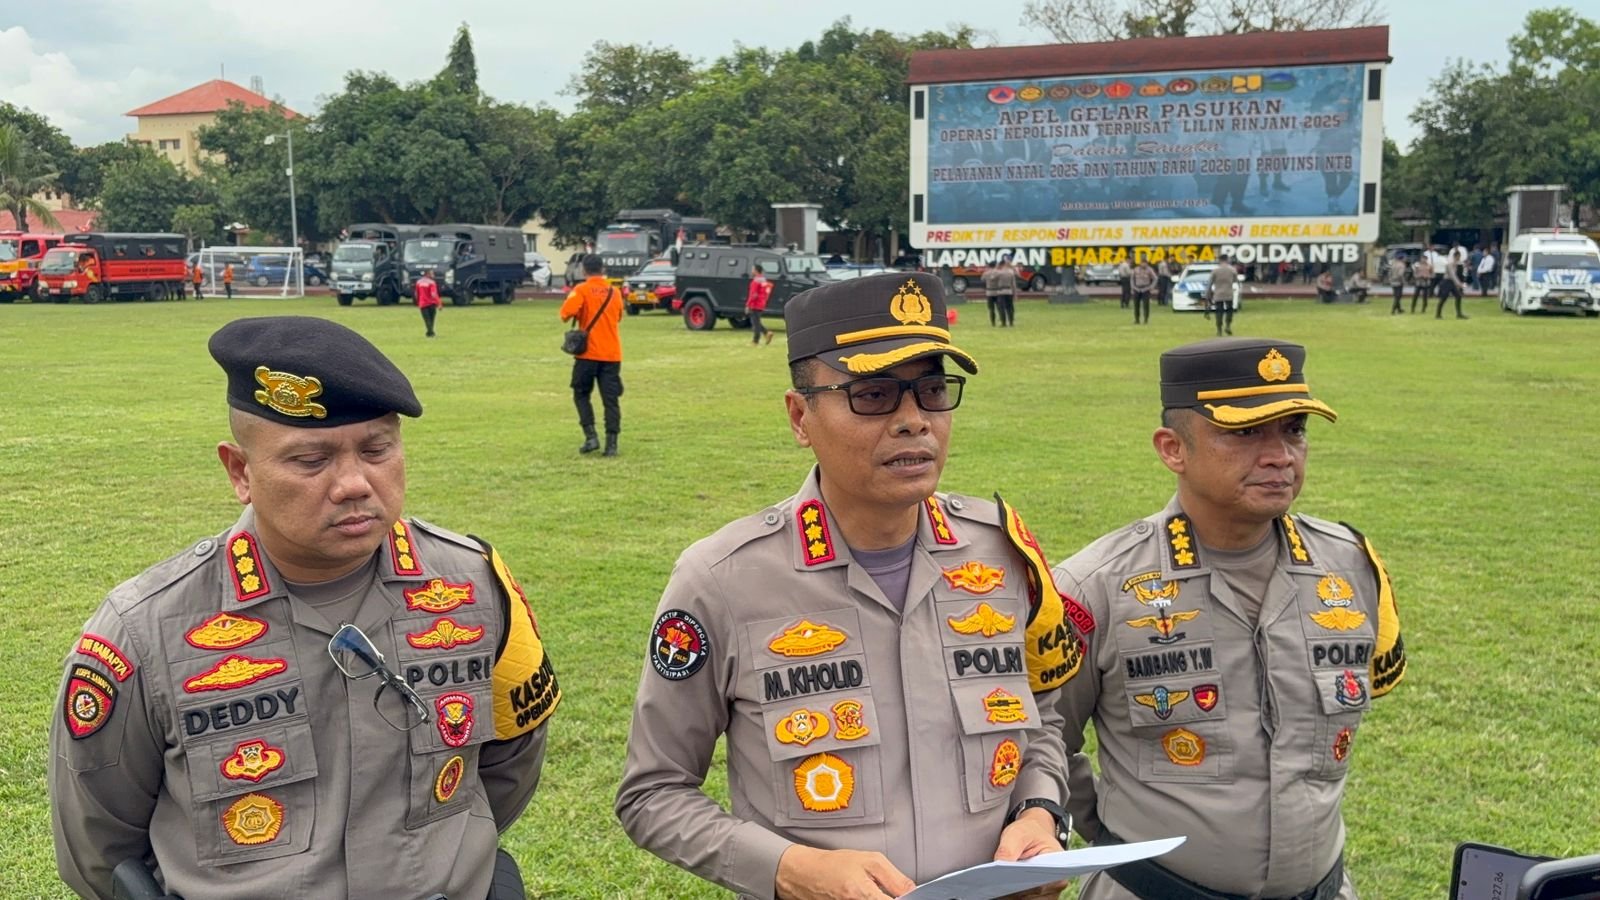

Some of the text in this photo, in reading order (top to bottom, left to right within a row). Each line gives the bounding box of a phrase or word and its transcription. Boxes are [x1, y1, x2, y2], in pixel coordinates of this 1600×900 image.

[1000, 99, 1282, 126] APEL GELAR PASUKAN
[940, 127, 998, 142] OPERASI
[1004, 124, 1089, 140] KEPOLISIAN
[1097, 120, 1171, 136] TERPUSAT
[933, 155, 1353, 182] PELAYANAN NATAL 2025 DAN TAHUN BARU 2026 DI PROVINSI NTB
[926, 229, 996, 243] PREDIKTIF
[1002, 227, 1123, 241] RESPONSIBILITAS
[1132, 224, 1243, 239] TRANSPARANSI
[1052, 246, 1128, 266] BHARA
[1221, 243, 1304, 263] POLDA
[1309, 243, 1359, 263] NTB
[92, 641, 128, 676] SAMAPTA
[953, 646, 1022, 676] POLRI
[1126, 647, 1212, 678] BAMBANG Y.W
[1313, 643, 1373, 666] POLRI
[406, 656, 491, 689] POLRI
[764, 659, 863, 701] M.KHOLID
[184, 687, 299, 736] DEDDY
